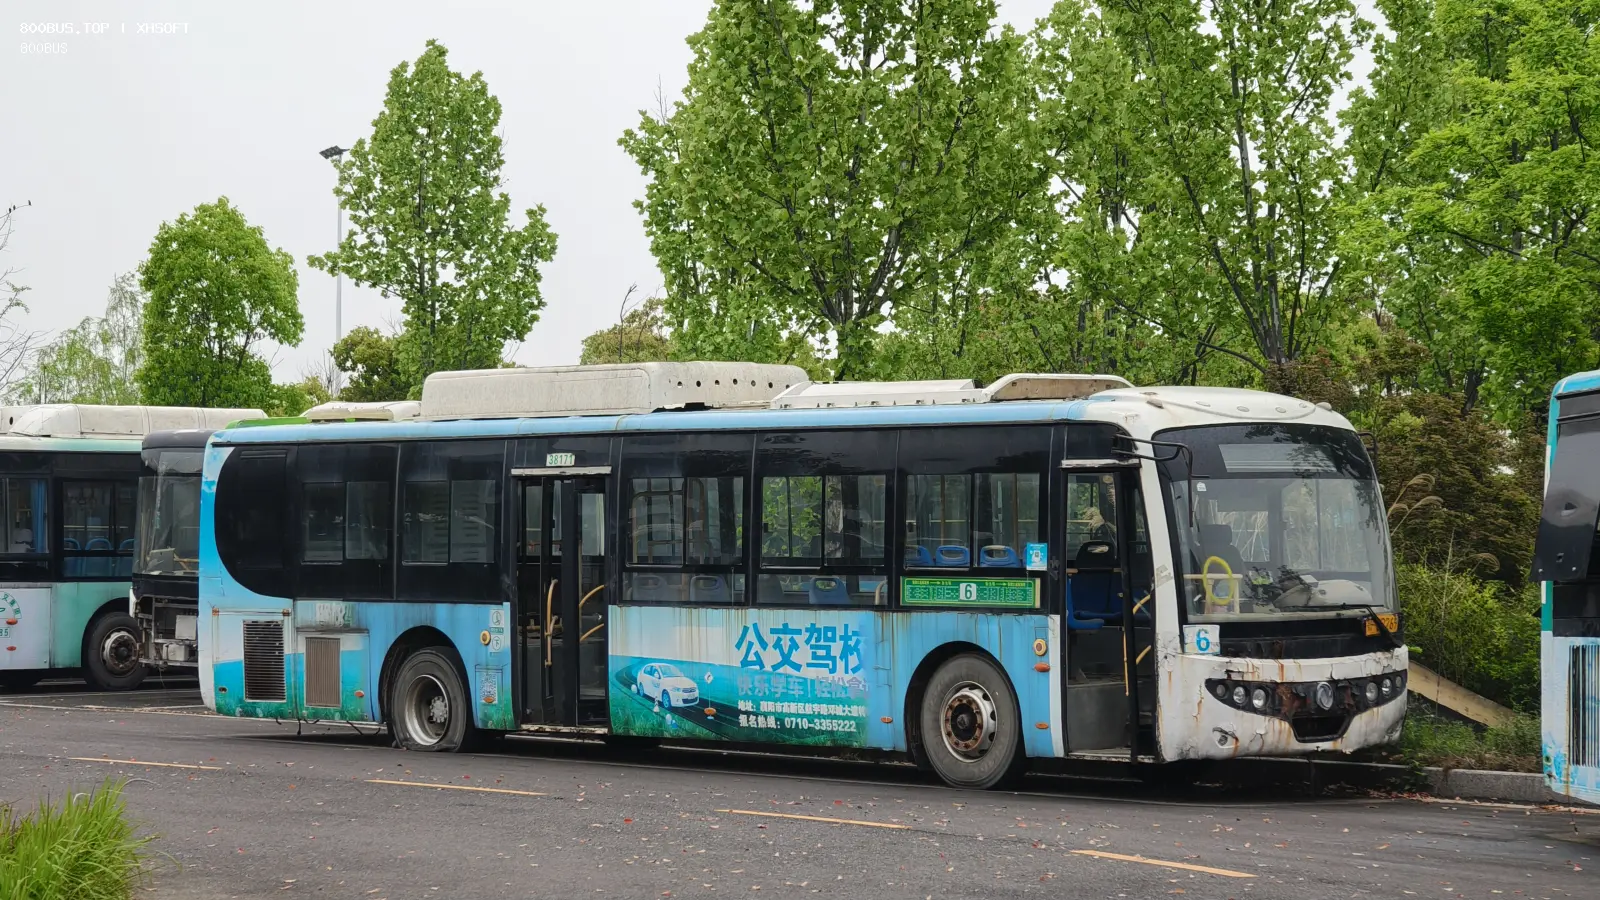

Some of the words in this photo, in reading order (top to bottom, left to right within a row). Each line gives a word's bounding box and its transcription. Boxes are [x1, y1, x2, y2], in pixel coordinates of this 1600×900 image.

[549, 454, 573, 465] 38171
[964, 583, 973, 599] 6
[1196, 628, 1210, 652] 6
